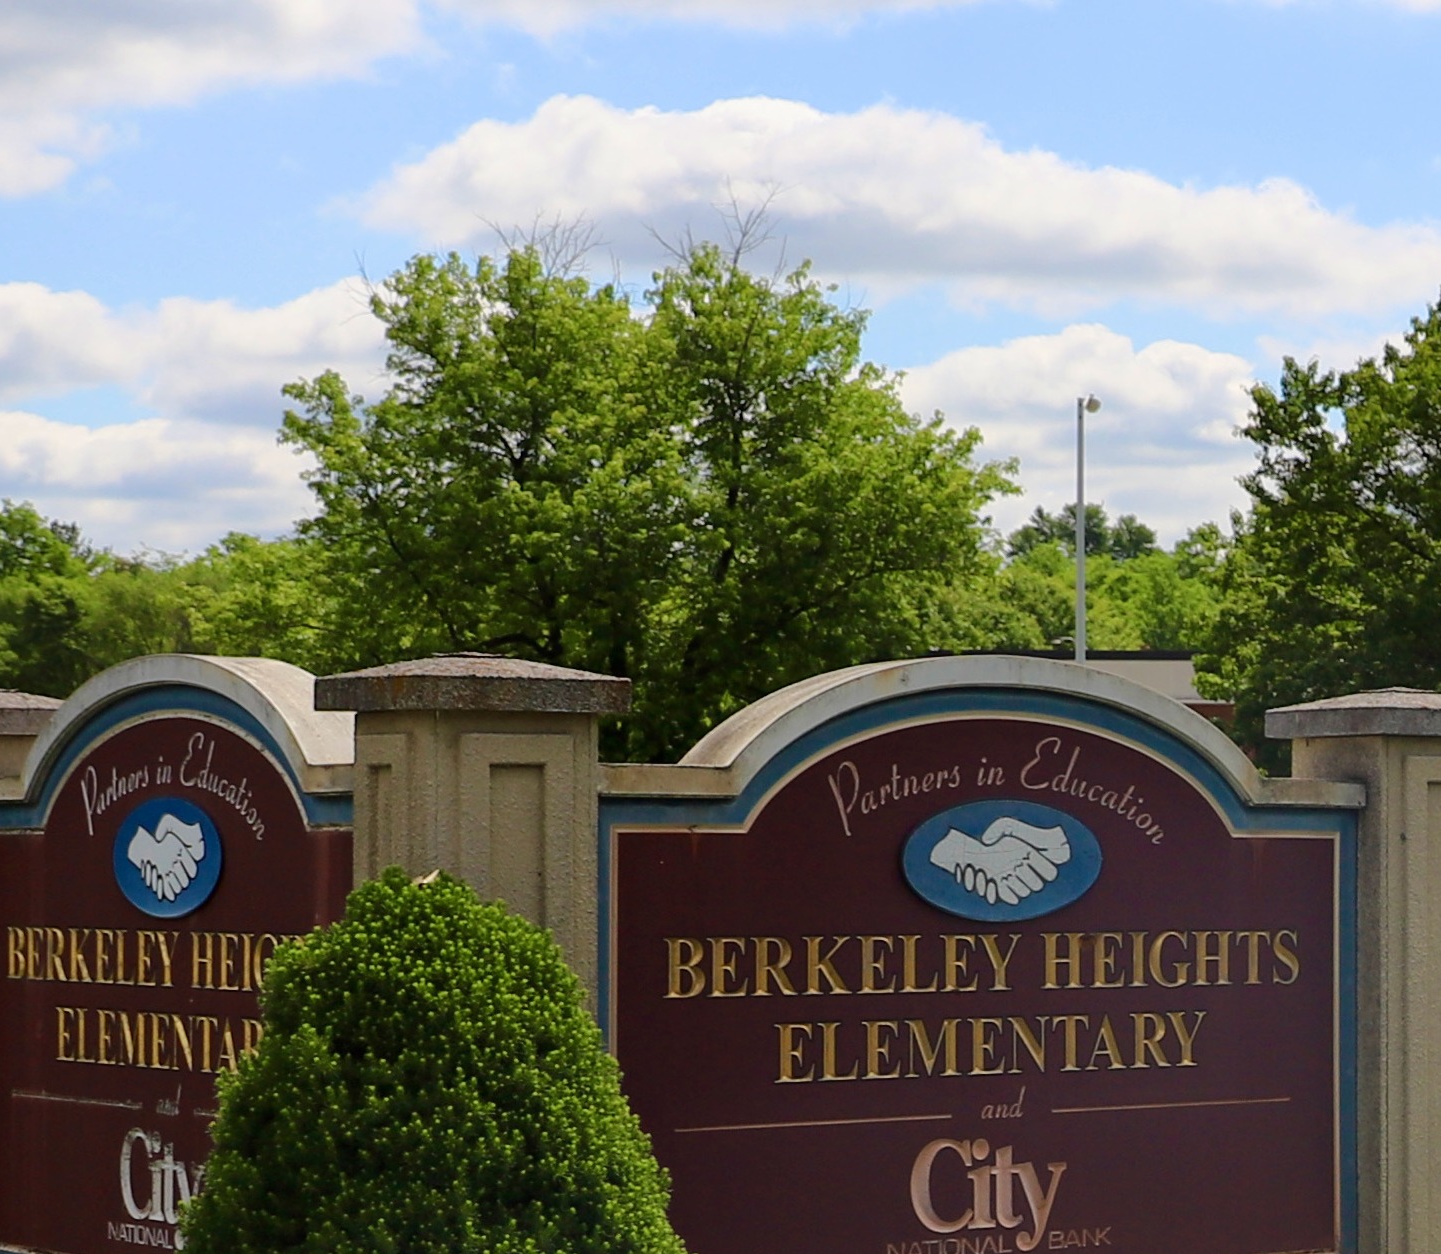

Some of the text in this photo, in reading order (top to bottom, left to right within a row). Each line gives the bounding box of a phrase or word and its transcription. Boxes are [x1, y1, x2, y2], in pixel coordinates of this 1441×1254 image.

[81, 732, 266, 841] Partners in Education
[828, 737, 1164, 845] Partners in Education
[7, 926, 178, 987] BERKELEY
[662, 929, 1301, 999] BERKELEY HEIGHTS
[56, 1006, 263, 1074] ELEMENTAR
[773, 1010, 1207, 1084] ELEMENTARY
[981, 1086, 1026, 1119] and
[910, 1138, 1067, 1251] City
[108, 1221, 174, 1250] NATIONAL
[1048, 1226, 1112, 1250] BANK
